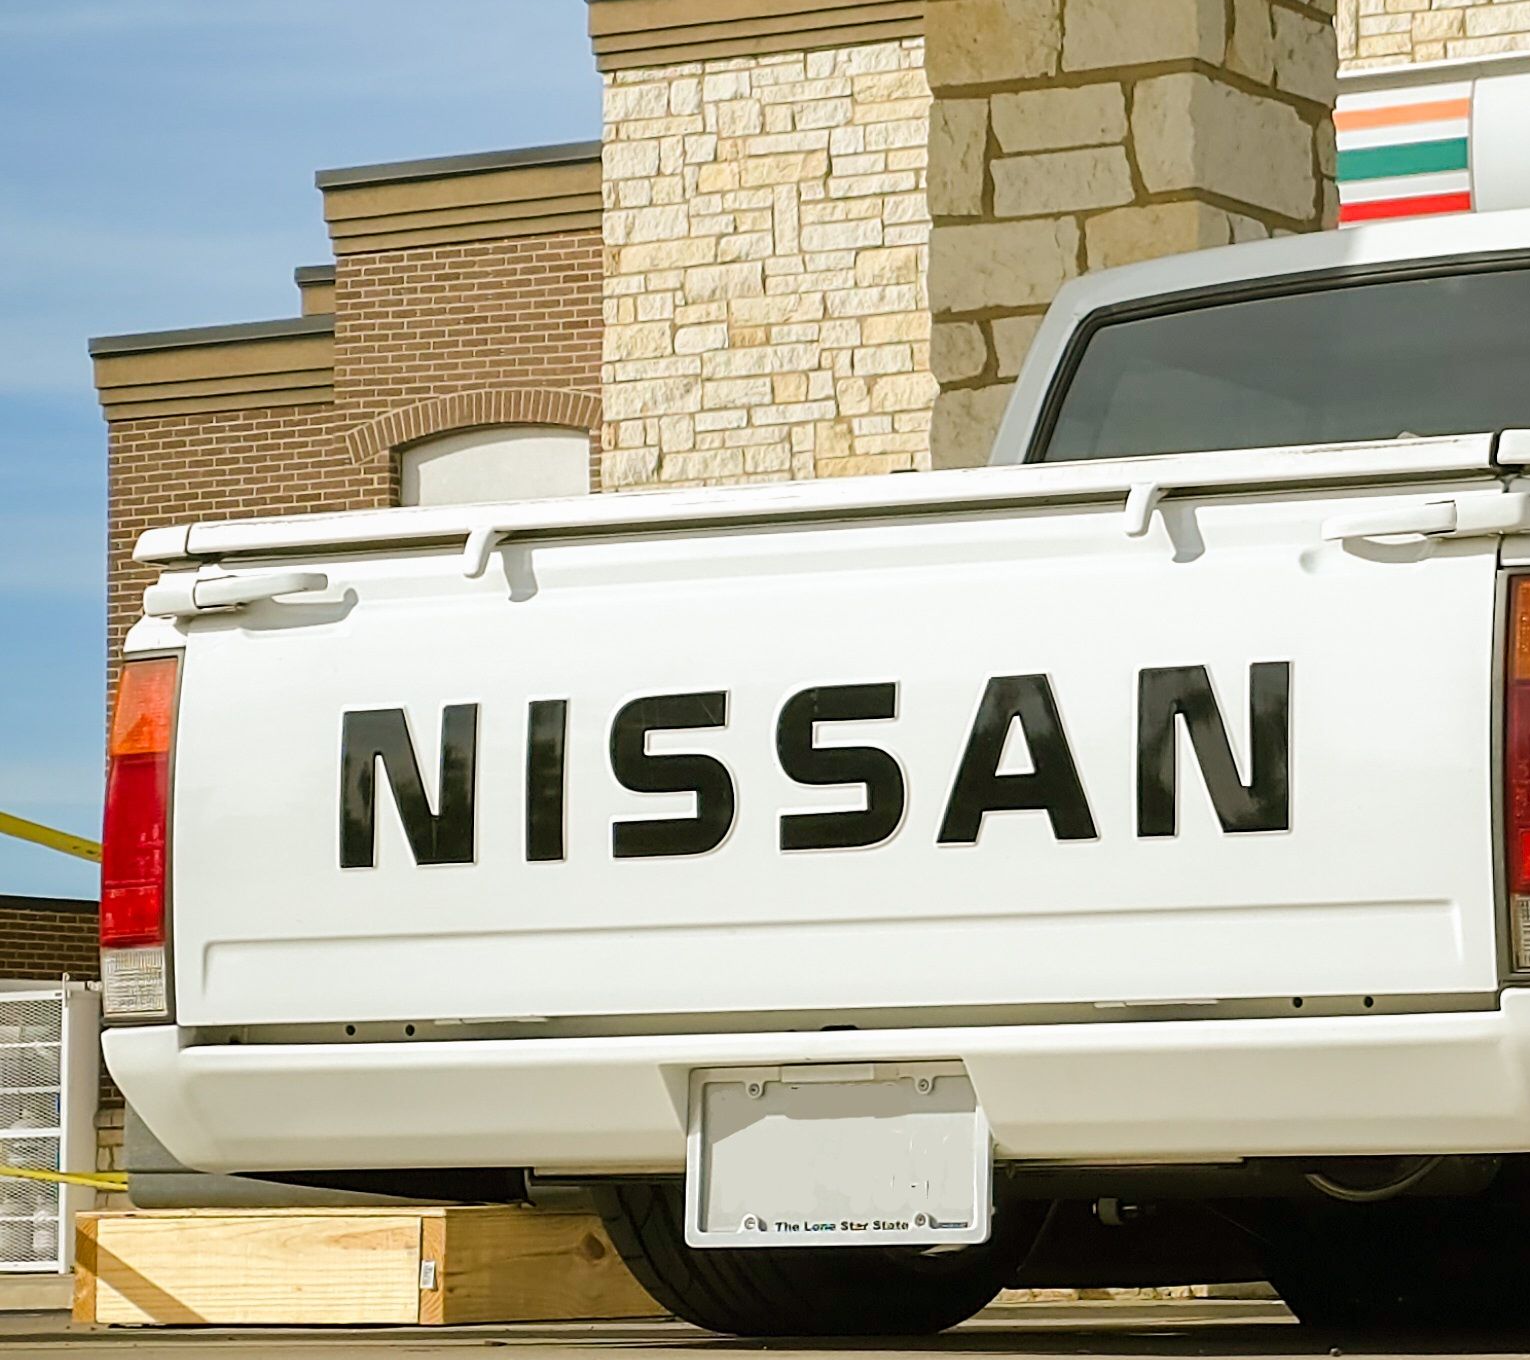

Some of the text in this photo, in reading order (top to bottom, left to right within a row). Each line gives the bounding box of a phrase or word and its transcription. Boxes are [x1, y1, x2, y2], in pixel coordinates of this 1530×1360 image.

[339, 660, 1294, 869] NISSAN
[775, 1219, 909, 1233] The Lone Star State
